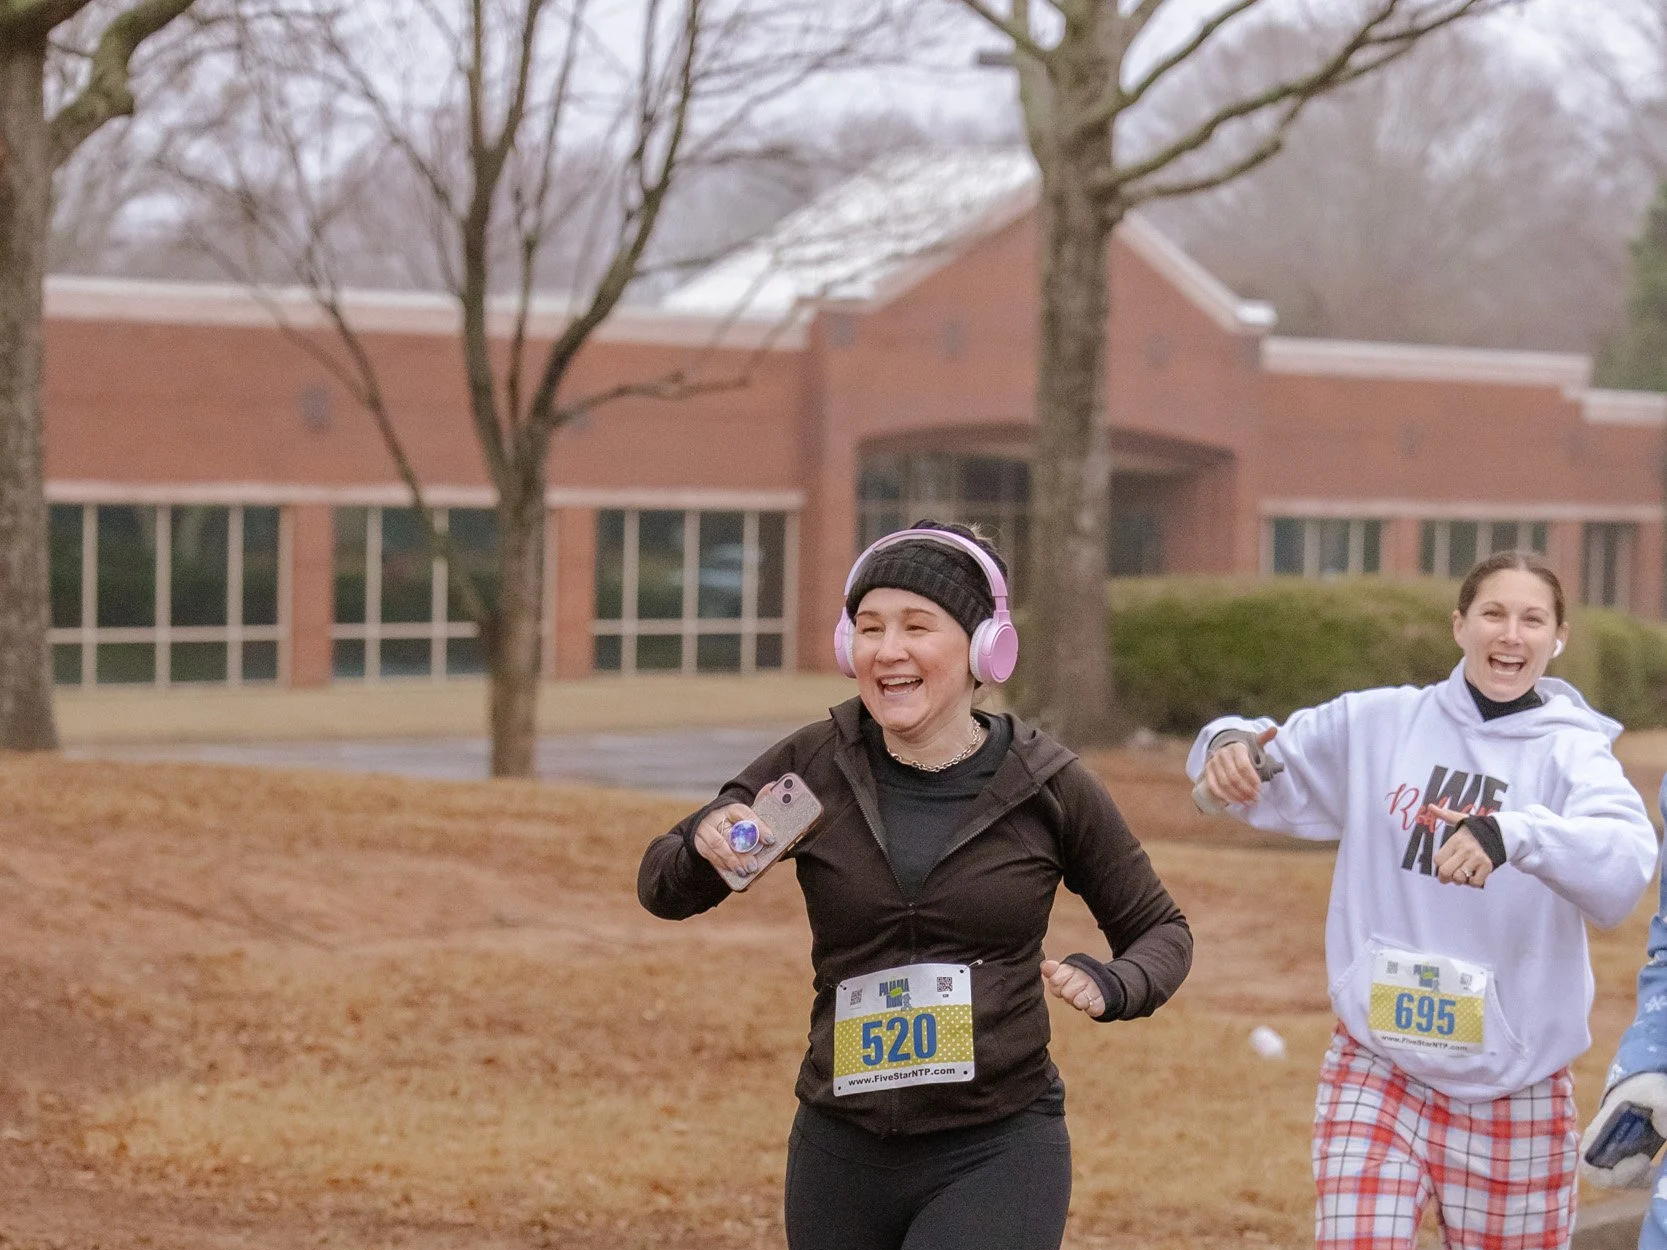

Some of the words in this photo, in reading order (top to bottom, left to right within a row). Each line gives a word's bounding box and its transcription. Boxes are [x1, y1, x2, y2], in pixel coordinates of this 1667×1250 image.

[1420, 765, 1509, 816] WE
[1395, 993, 1456, 1036] 695
[862, 1013, 937, 1066] 520
[848, 1066, 956, 1086] www.FiveStarNTP.com
